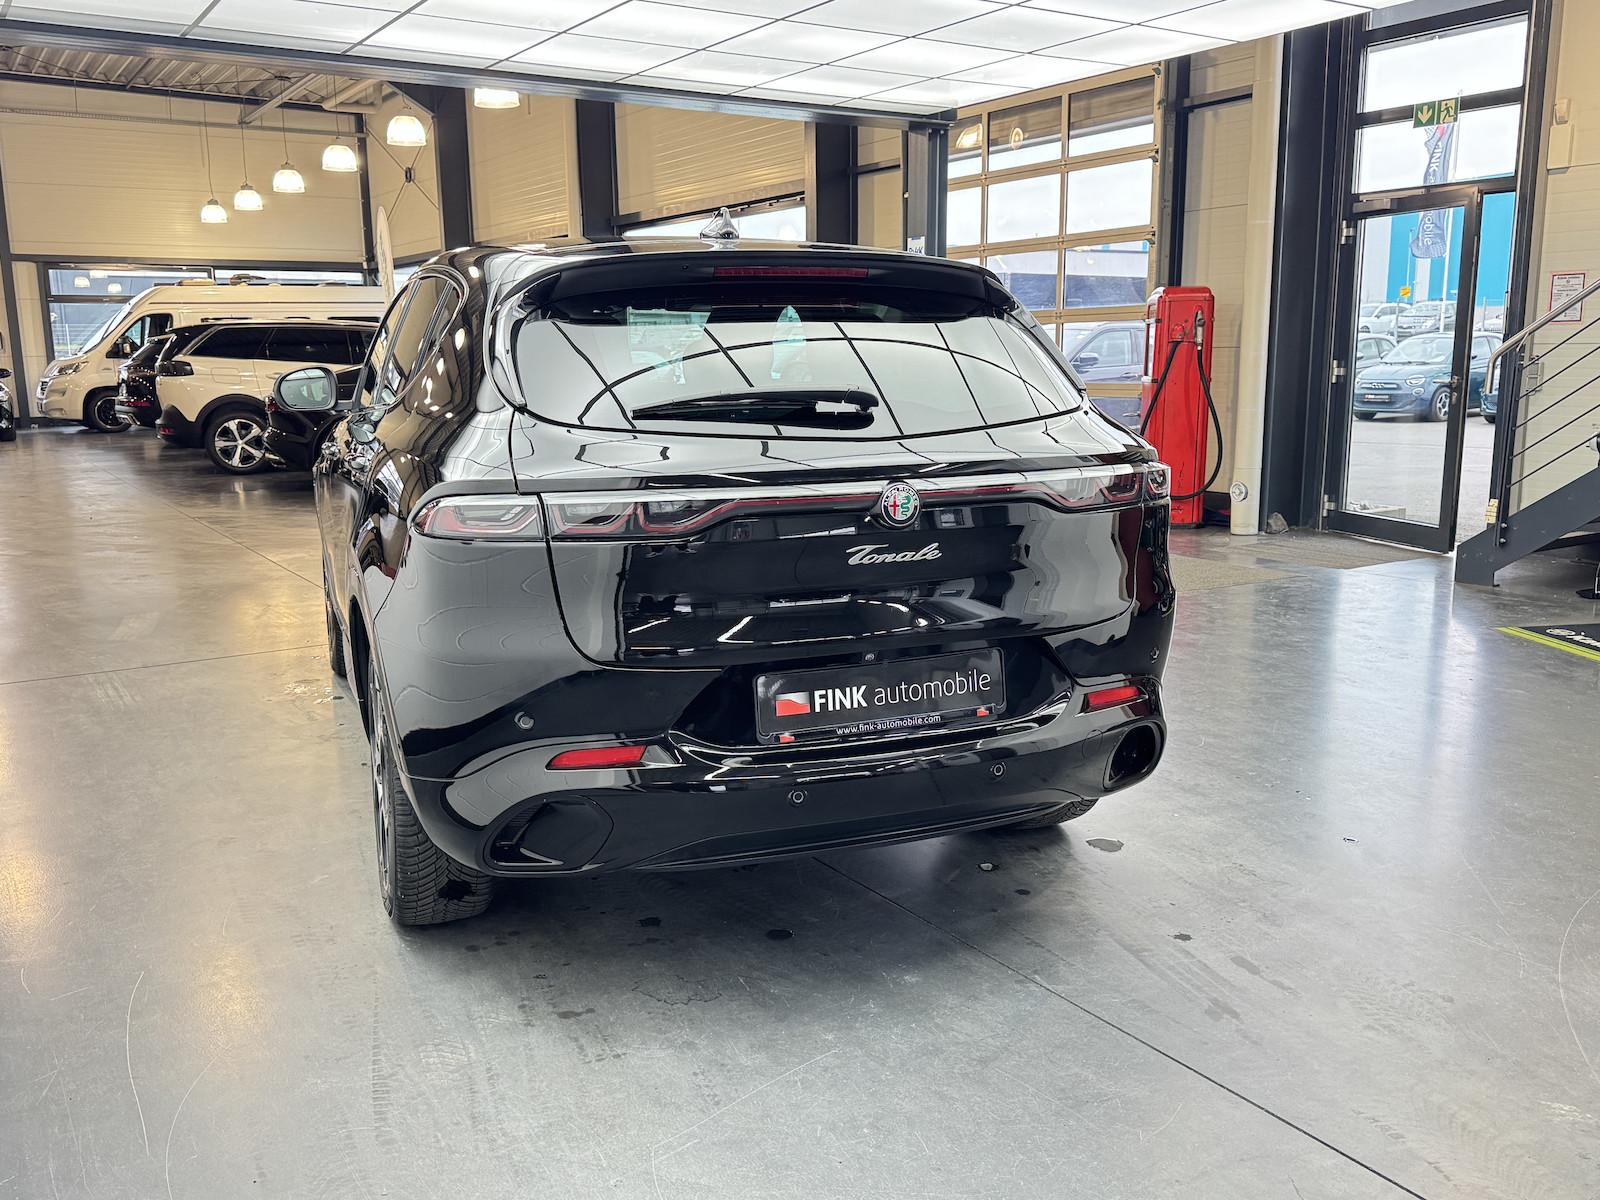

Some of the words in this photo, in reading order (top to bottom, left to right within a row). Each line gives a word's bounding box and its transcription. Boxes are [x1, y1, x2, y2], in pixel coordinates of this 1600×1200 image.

[846, 542, 942, 566] Tonale
[813, 685, 868, 713] FINK
[873, 668, 991, 706] automobile
[836, 714, 941, 736] www.fink-automobile.com
